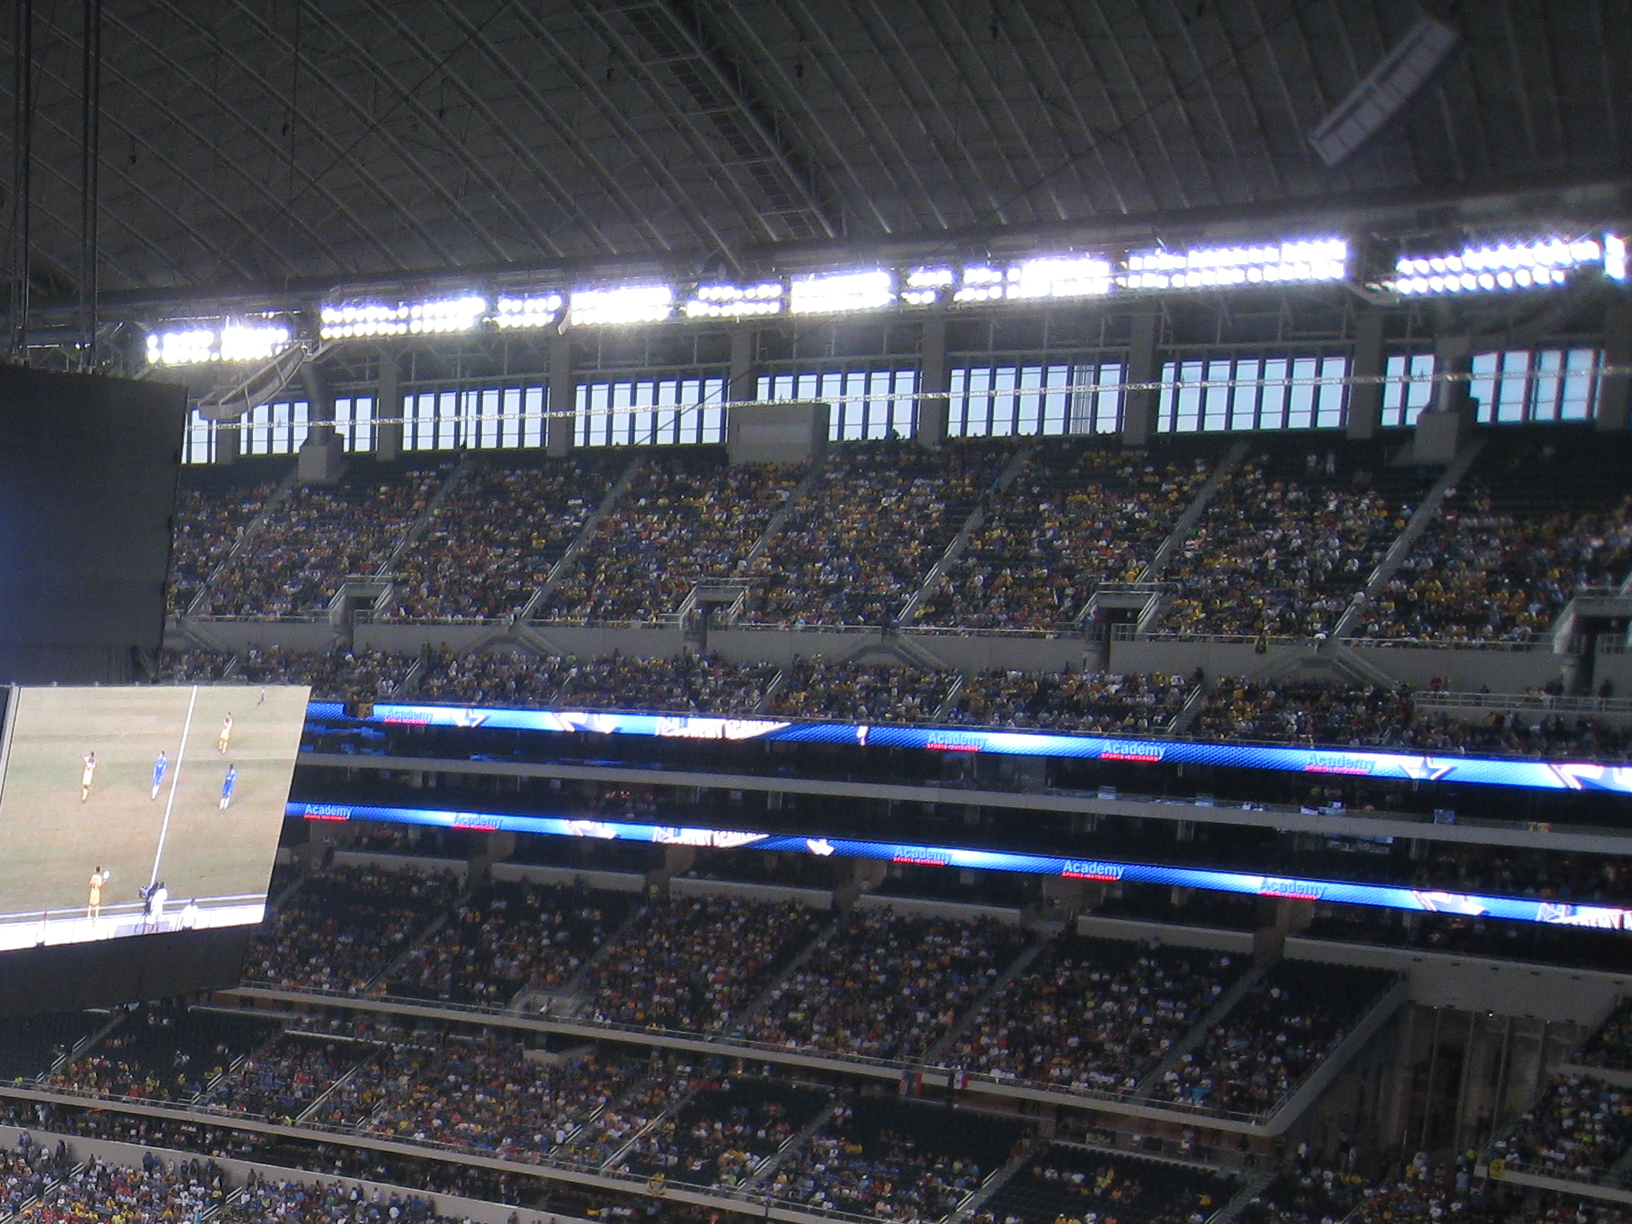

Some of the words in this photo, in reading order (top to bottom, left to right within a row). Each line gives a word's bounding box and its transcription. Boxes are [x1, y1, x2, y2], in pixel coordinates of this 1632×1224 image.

[927, 731, 987, 746] Academy
[1102, 740, 1166, 758] Academy
[304, 803, 353, 819] Academy
[894, 846, 952, 863] Academy
[1063, 859, 1125, 879] Academy
